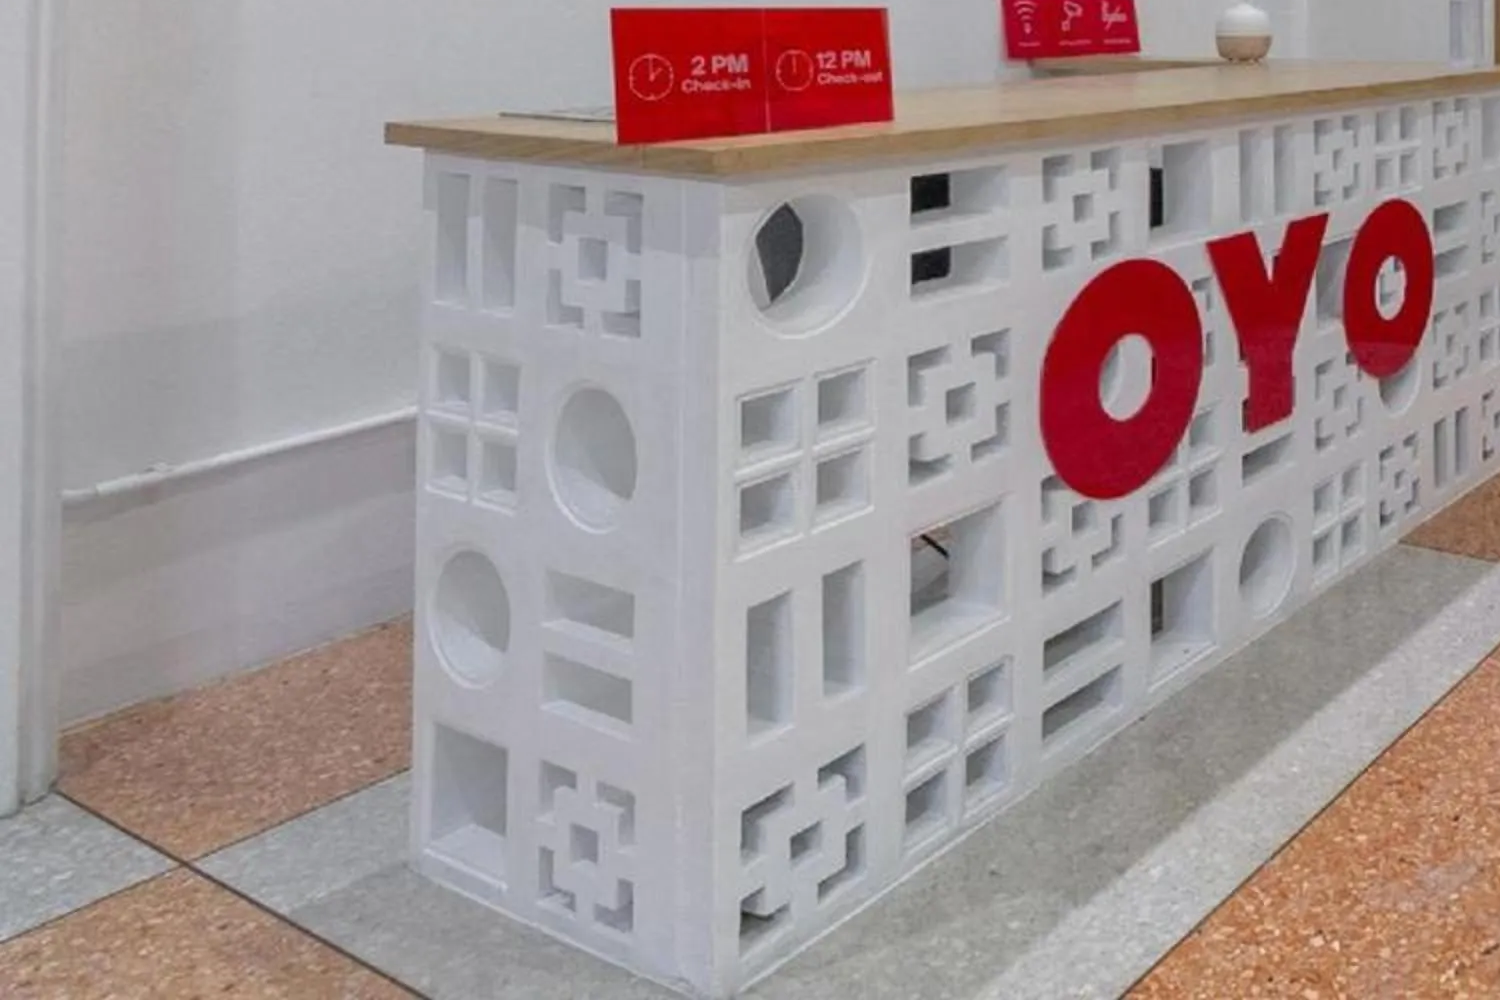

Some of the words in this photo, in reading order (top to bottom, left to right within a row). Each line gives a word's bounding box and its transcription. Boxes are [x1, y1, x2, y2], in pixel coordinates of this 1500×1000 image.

[691, 55, 706, 76] 2
[711, 53, 749, 74] PM
[816, 51, 838, 69] 12
[841, 50, 871, 69] PM
[681, 77, 752, 94] Check-in
[817, 71, 883, 85] Check-out
[1040, 198, 1434, 500] OYO
